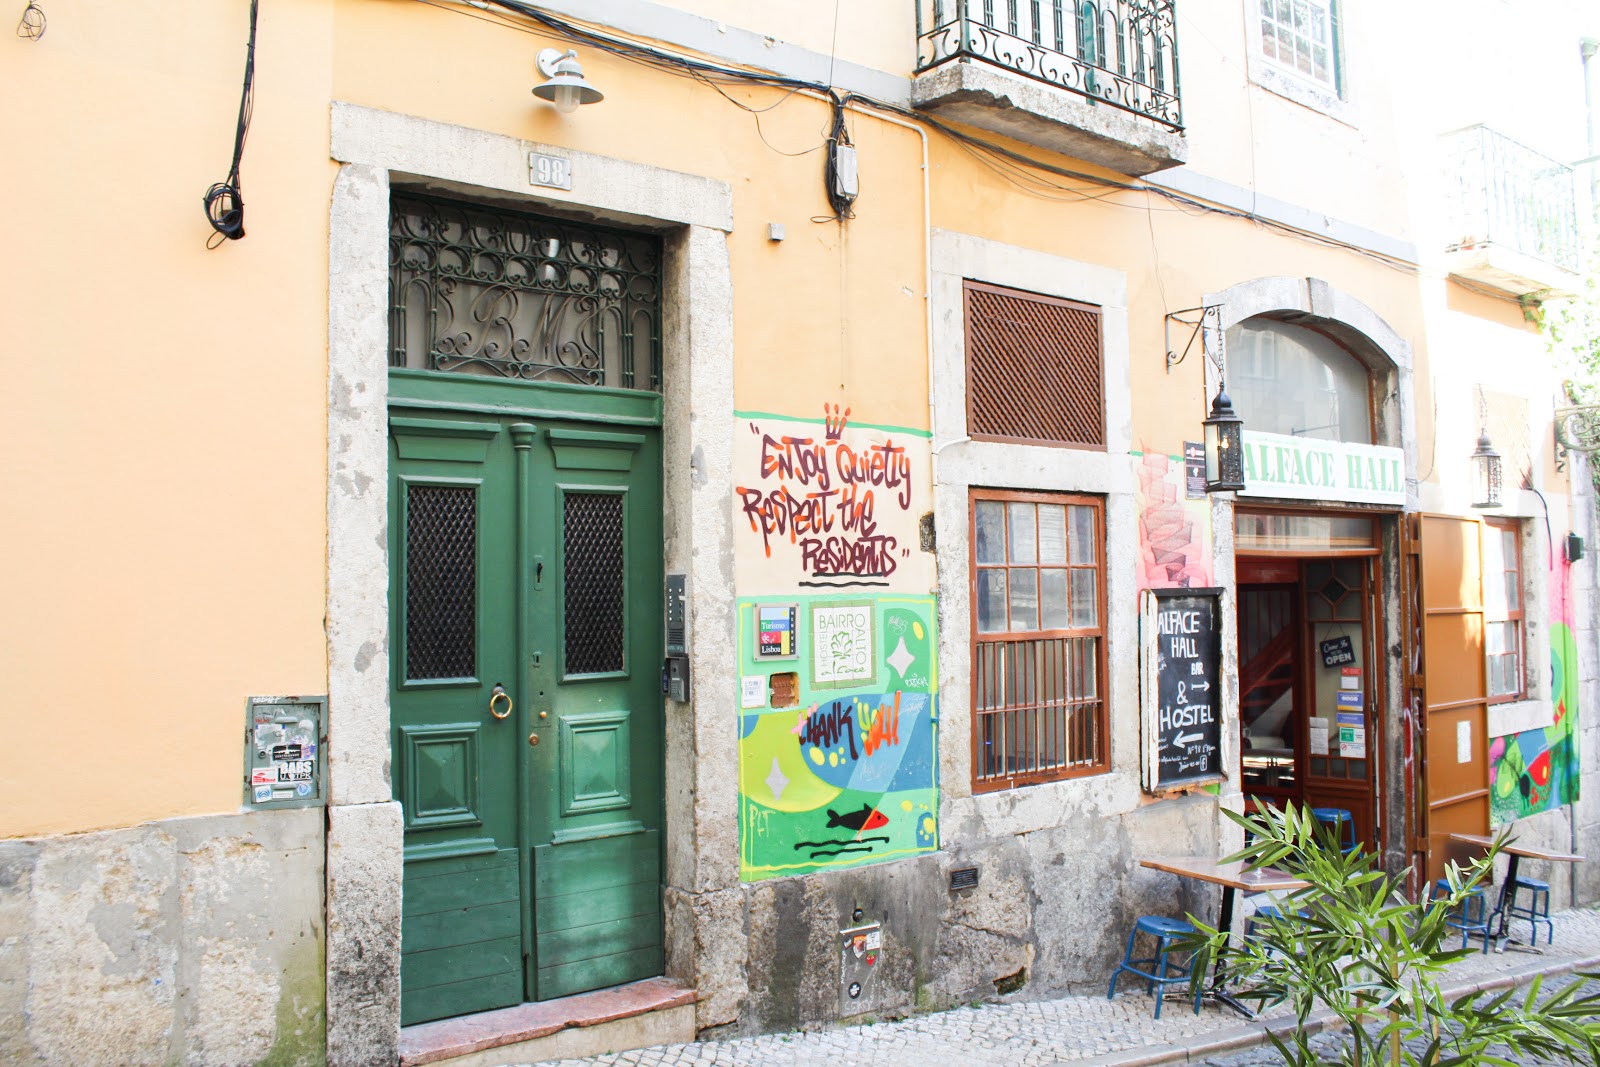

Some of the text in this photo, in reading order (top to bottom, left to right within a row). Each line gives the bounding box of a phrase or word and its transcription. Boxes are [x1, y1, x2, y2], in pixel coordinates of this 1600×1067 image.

[538, 157, 564, 185] 98
[1244, 443, 1336, 488] ALFACE
[1346, 454, 1405, 493] HALL
[761, 622, 786, 630] Turismo
[819, 613, 866, 630] BAIRRO
[1157, 611, 1200, 635] ALFACE
[761, 645, 781, 653] Lisboa
[819, 628, 828, 667] HOSTEL
[854, 628, 867, 665] ALTO
[1171, 637, 1199, 659] HALL
[1191, 662, 1204, 676] BAR
[1325, 652, 1352, 665] OPEN
[1176, 681, 1188, 705] &
[1159, 705, 1215, 733] HOSTEL
[280, 761, 312, 774] BABS
